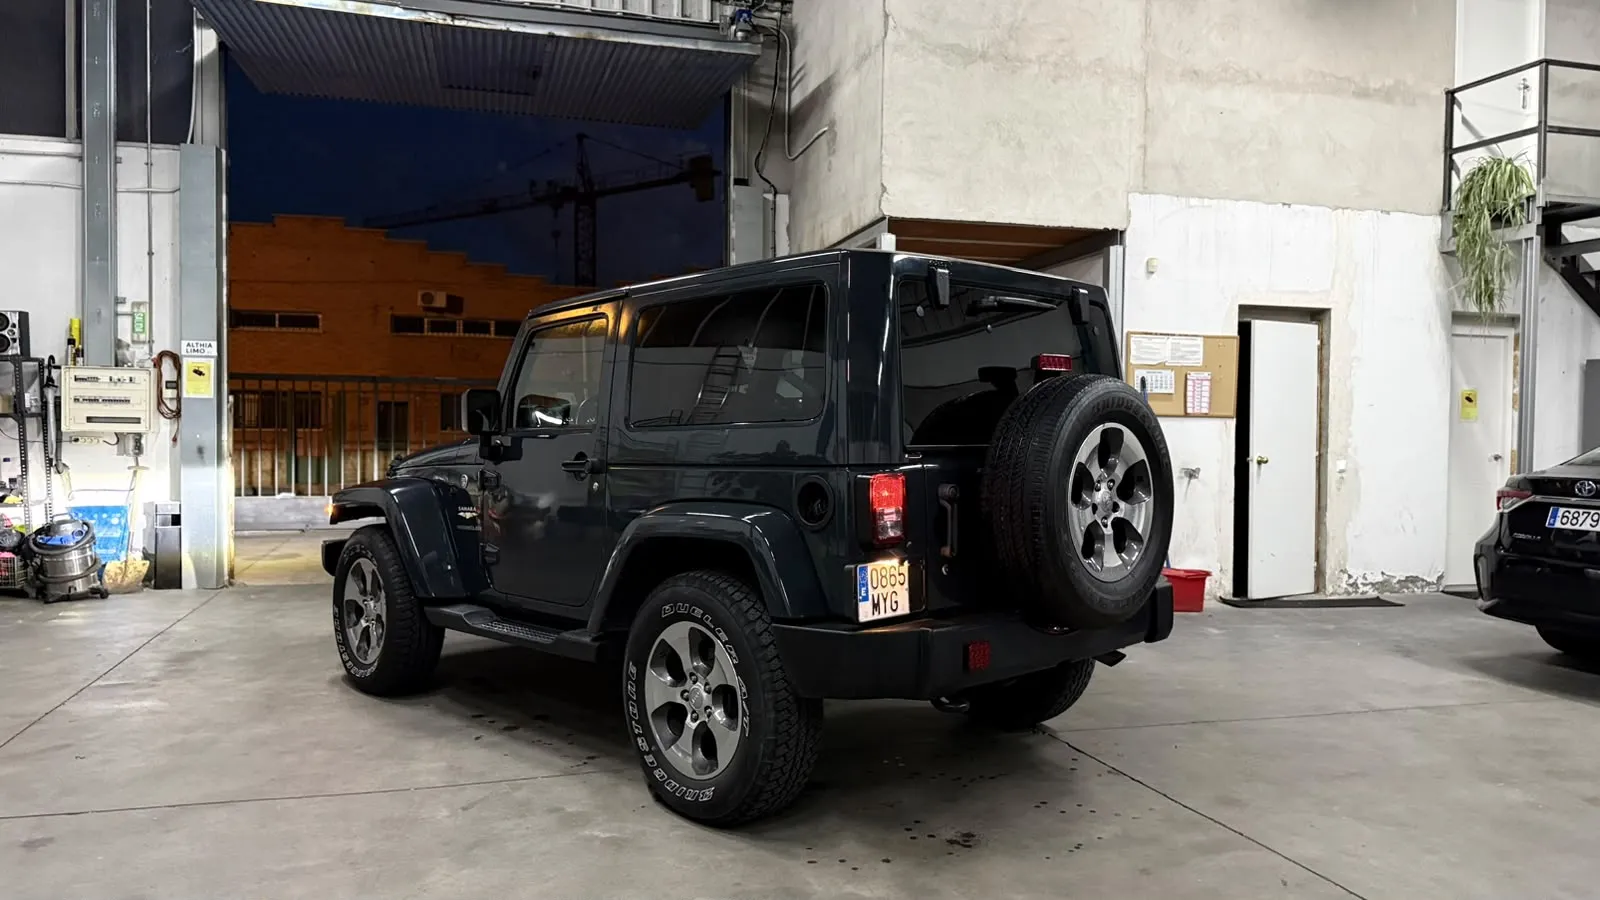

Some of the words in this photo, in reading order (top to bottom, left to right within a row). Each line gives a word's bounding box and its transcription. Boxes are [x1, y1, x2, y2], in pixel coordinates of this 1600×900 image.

[1560, 510, 1600, 528] 6879
[870, 565, 906, 590] 0865
[871, 590, 899, 617] MYG
[661, 602, 739, 665] DUELER
[628, 661, 716, 802] BRIDGESTONE
